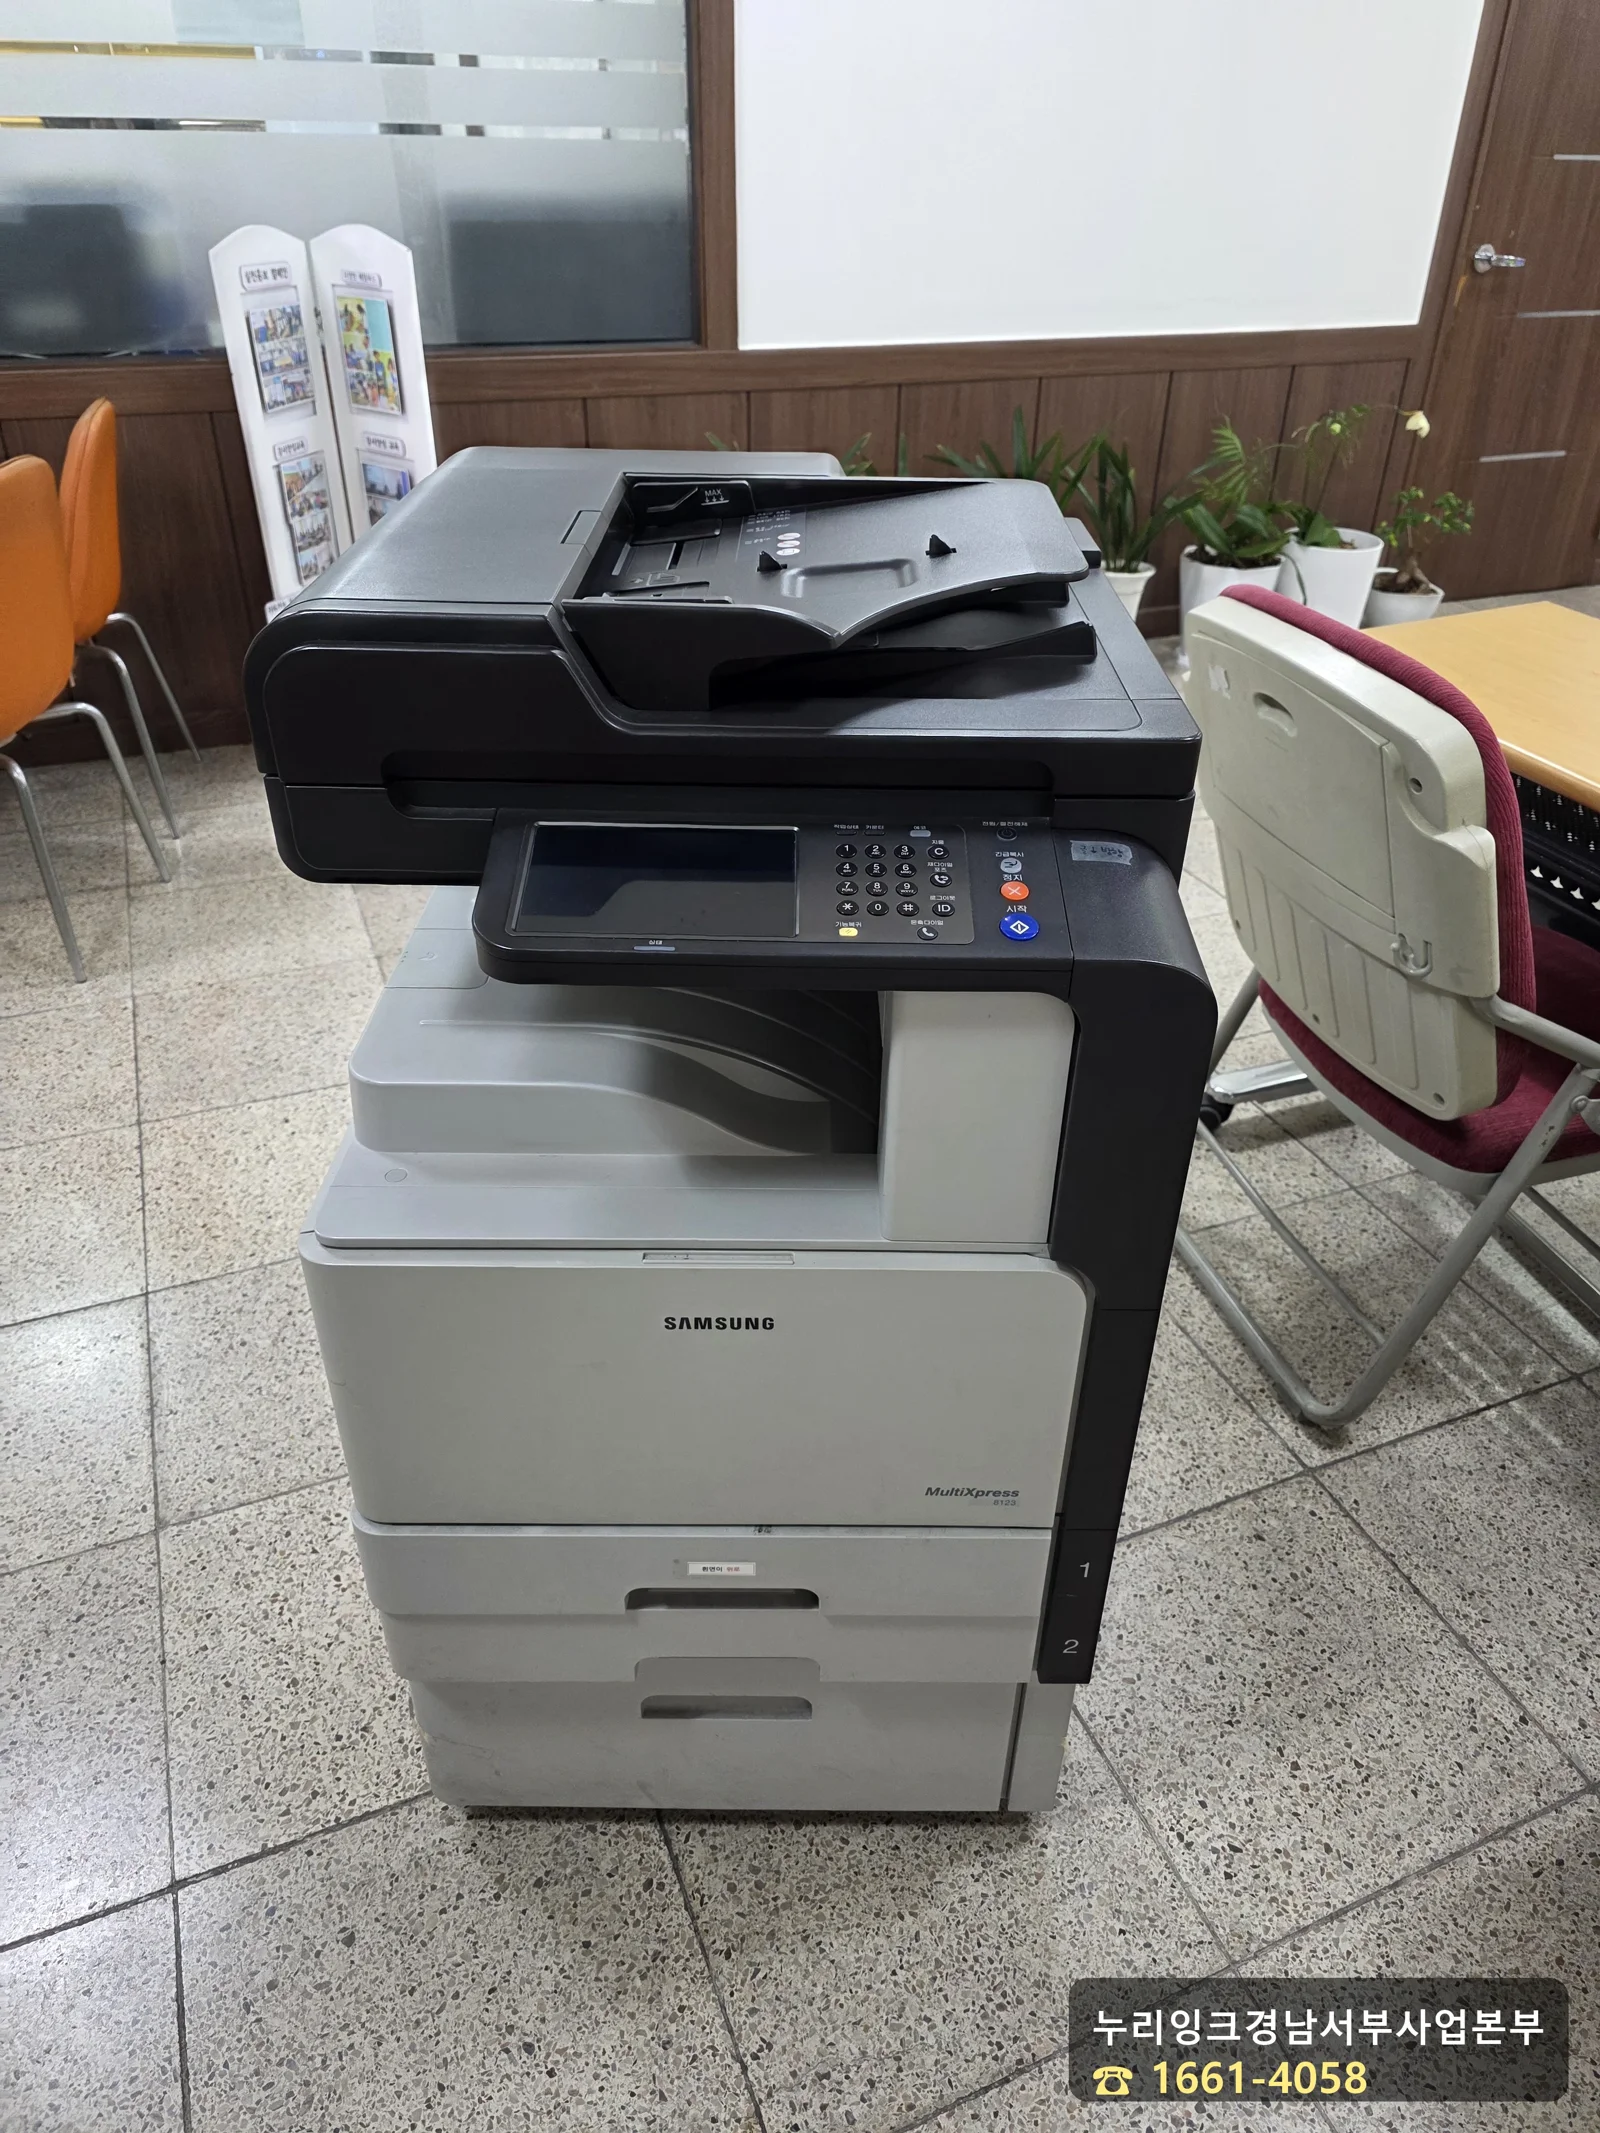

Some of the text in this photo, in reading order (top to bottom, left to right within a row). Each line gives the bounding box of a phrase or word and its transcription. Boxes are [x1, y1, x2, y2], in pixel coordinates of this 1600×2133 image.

[704, 488, 722, 497] MAX
[901, 845, 909, 853] 3
[933, 847, 944, 855] C
[844, 881, 851, 889] 7
[903, 882, 911, 890] 9
[874, 903, 882, 911] 0
[902, 903, 914, 912] #
[937, 904, 951, 912] ID
[1006, 905, 1028, 913] 시작
[663, 1316, 775, 1331] SAMSUNG
[925, 1486, 1020, 1499] MultiXpress
[1080, 1562, 1090, 1578] 1
[1062, 1639, 1079, 1654] 2
